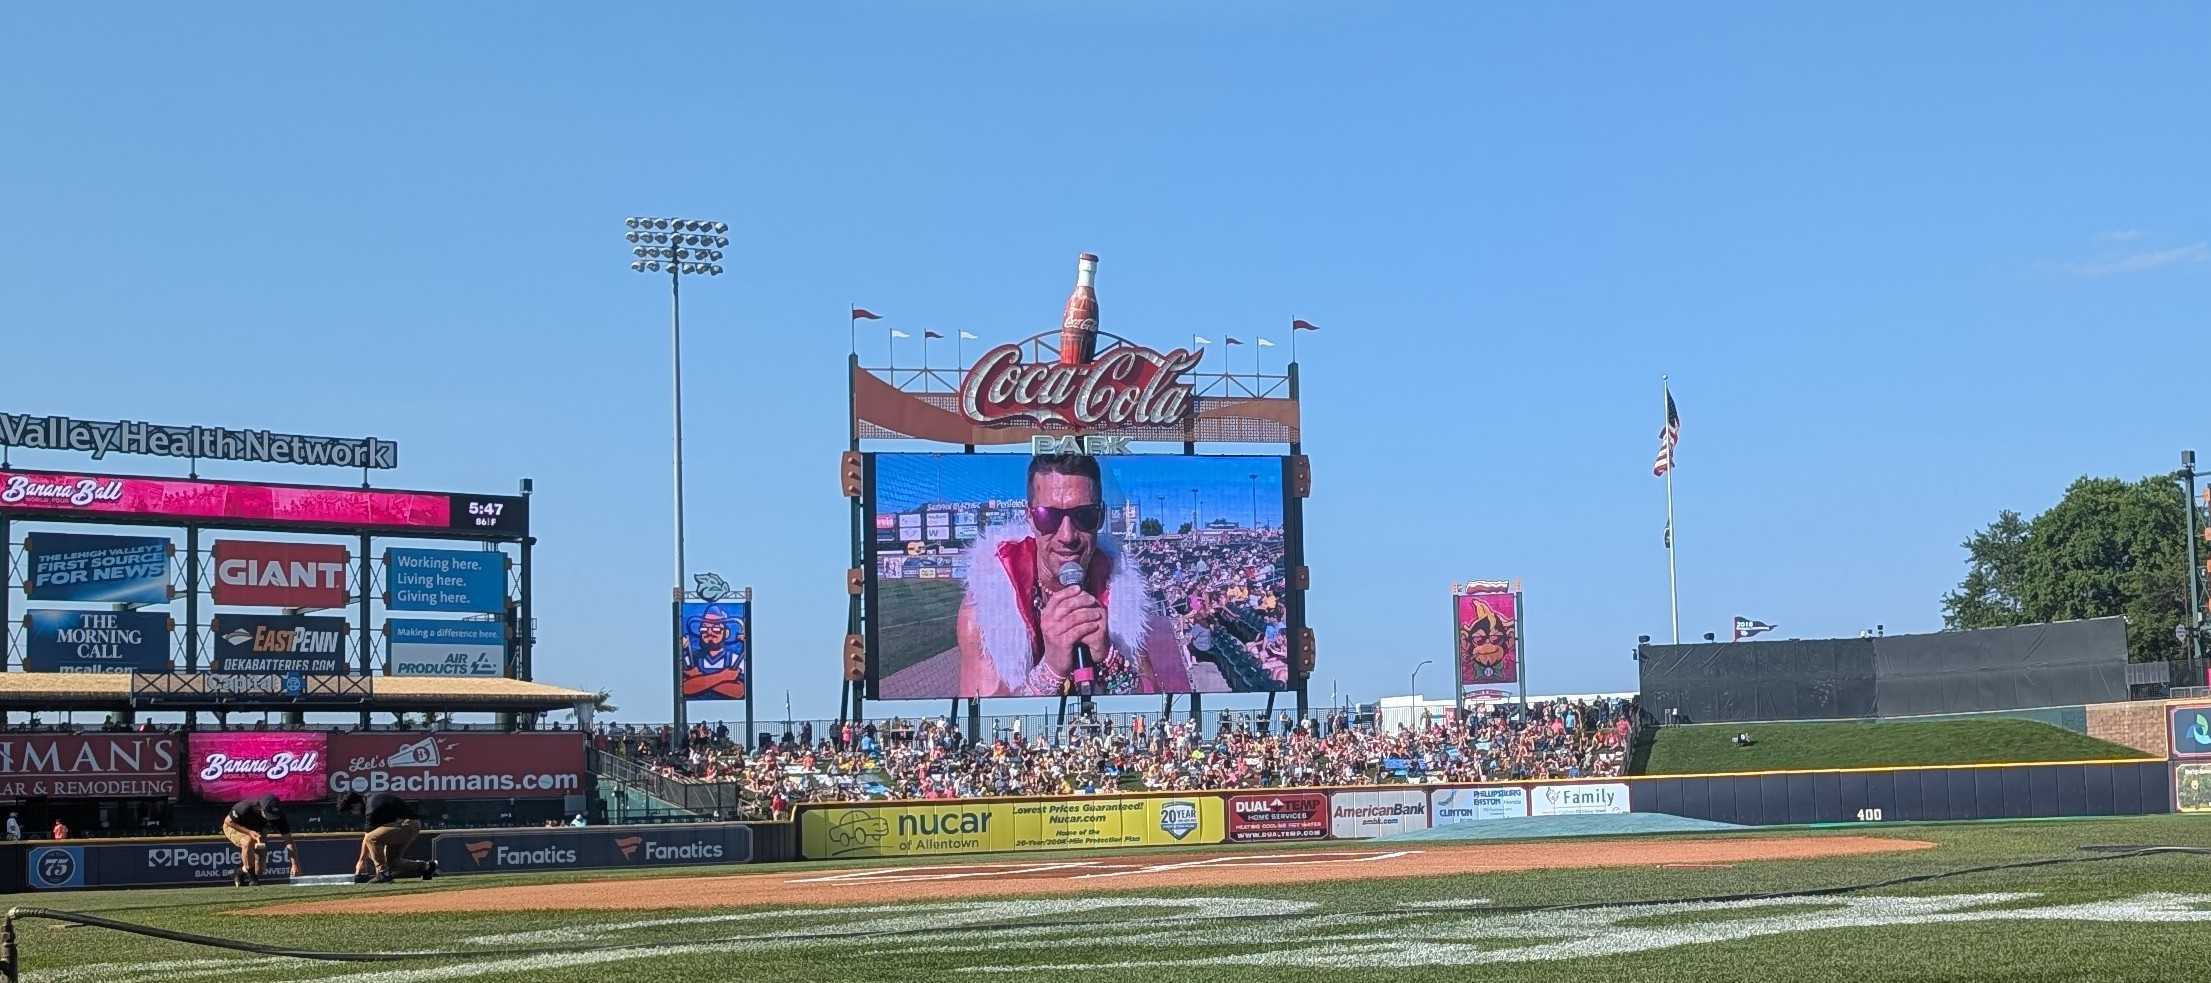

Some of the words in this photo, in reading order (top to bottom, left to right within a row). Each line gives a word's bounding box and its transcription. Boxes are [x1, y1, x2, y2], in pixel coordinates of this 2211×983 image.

[962, 346, 1203, 424] Coca-Cola
[0, 413, 114, 460] Valley
[121, 421, 237, 459] Health
[245, 429, 388, 468] Network
[1032, 435, 1134, 456] PARK
[2, 476, 73, 502] Banana
[71, 480, 122, 506] Ball
[468, 502, 504, 515] 5:47
[37, 558, 89, 573] FIRST
[91, 552, 164, 568] SOURCE
[38, 554, 61, 563] THE
[63, 549, 106, 561] LEHIGH
[397, 556, 449, 572] Working
[452, 558, 482, 571] here.
[36, 570, 89, 587] FOR
[93, 563, 165, 581] NEWS
[218, 558, 343, 589] GIANT
[397, 573, 434, 589] Living
[436, 574, 467, 587] here.
[397, 590, 438, 606] Giving
[440, 591, 471, 604] here.
[80, 613, 118, 629] THE
[56, 629, 142, 645] MORNING
[397, 627, 429, 639] Making
[437, 628, 478, 638] difference
[77, 644, 122, 659] CALL
[444, 653, 469, 664] AIR
[223, 658, 336, 671] DEKABATTERIES.COM
[397, 662, 468, 675] PRODUCTS
[201, 753, 270, 780] Banana
[267, 752, 317, 779] Ball
[348, 755, 386, 772] Let's
[0, 783, 28, 796] AR
[33, 781, 48, 795] &
[54, 780, 174, 796] REMODELING
[329, 770, 578, 793] GoBachmans.com
[1473, 790, 1522, 798] PHILLIPSBURG
[1563, 788, 1615, 807] Family
[1012, 806, 1047, 814] Lowest
[1049, 805, 1079, 813] Prices
[1082, 802, 1144, 812] Guaranteed!
[1235, 801, 1271, 812] DUAL
[1284, 800, 1320, 811] TEMP
[1333, 801, 1426, 818] AmericanBank
[1439, 808, 1473, 817] CLINTON
[1857, 808, 1882, 820] 400
[898, 812, 992, 836] nucar
[1049, 815, 1106, 824] Nucar.com
[1161, 810, 1176, 824] 20
[1177, 809, 1197, 819] YEAR
[1237, 830, 1320, 838] WWW.DUALTEMP.COM
[645, 841, 723, 860] Fanatics
[899, 841, 912, 850] of
[916, 839, 979, 850] Allentown
[497, 846, 577, 865] Fanatics
